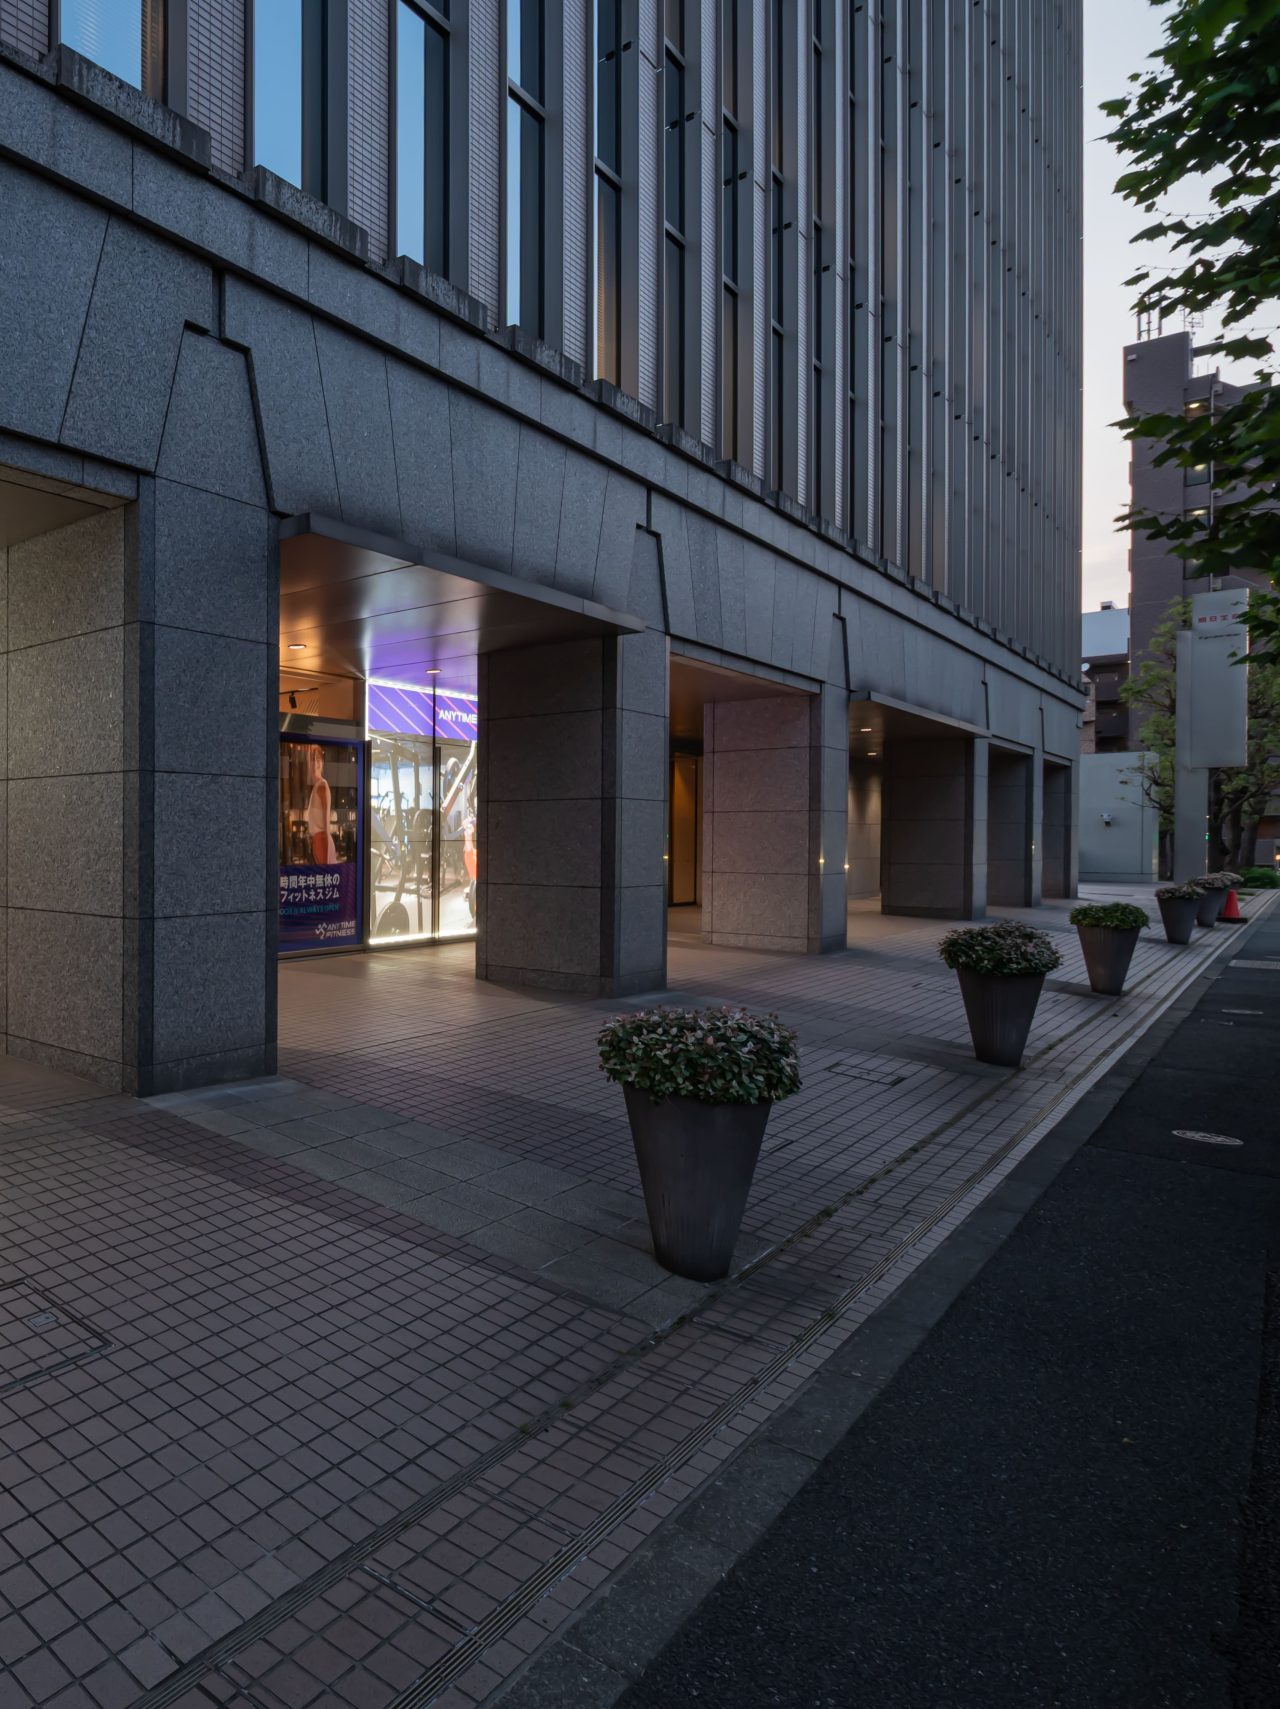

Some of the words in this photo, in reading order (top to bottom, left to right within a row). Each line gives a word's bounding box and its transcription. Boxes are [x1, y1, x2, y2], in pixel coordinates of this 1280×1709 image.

[438, 709, 478, 724] ANYTIME
[280, 874, 340, 889] 時間年中無休の
[280, 887, 340, 903] フィットネスジム
[328, 921, 356, 930] ANYTIME
[326, 929, 356, 938] FITNESS
